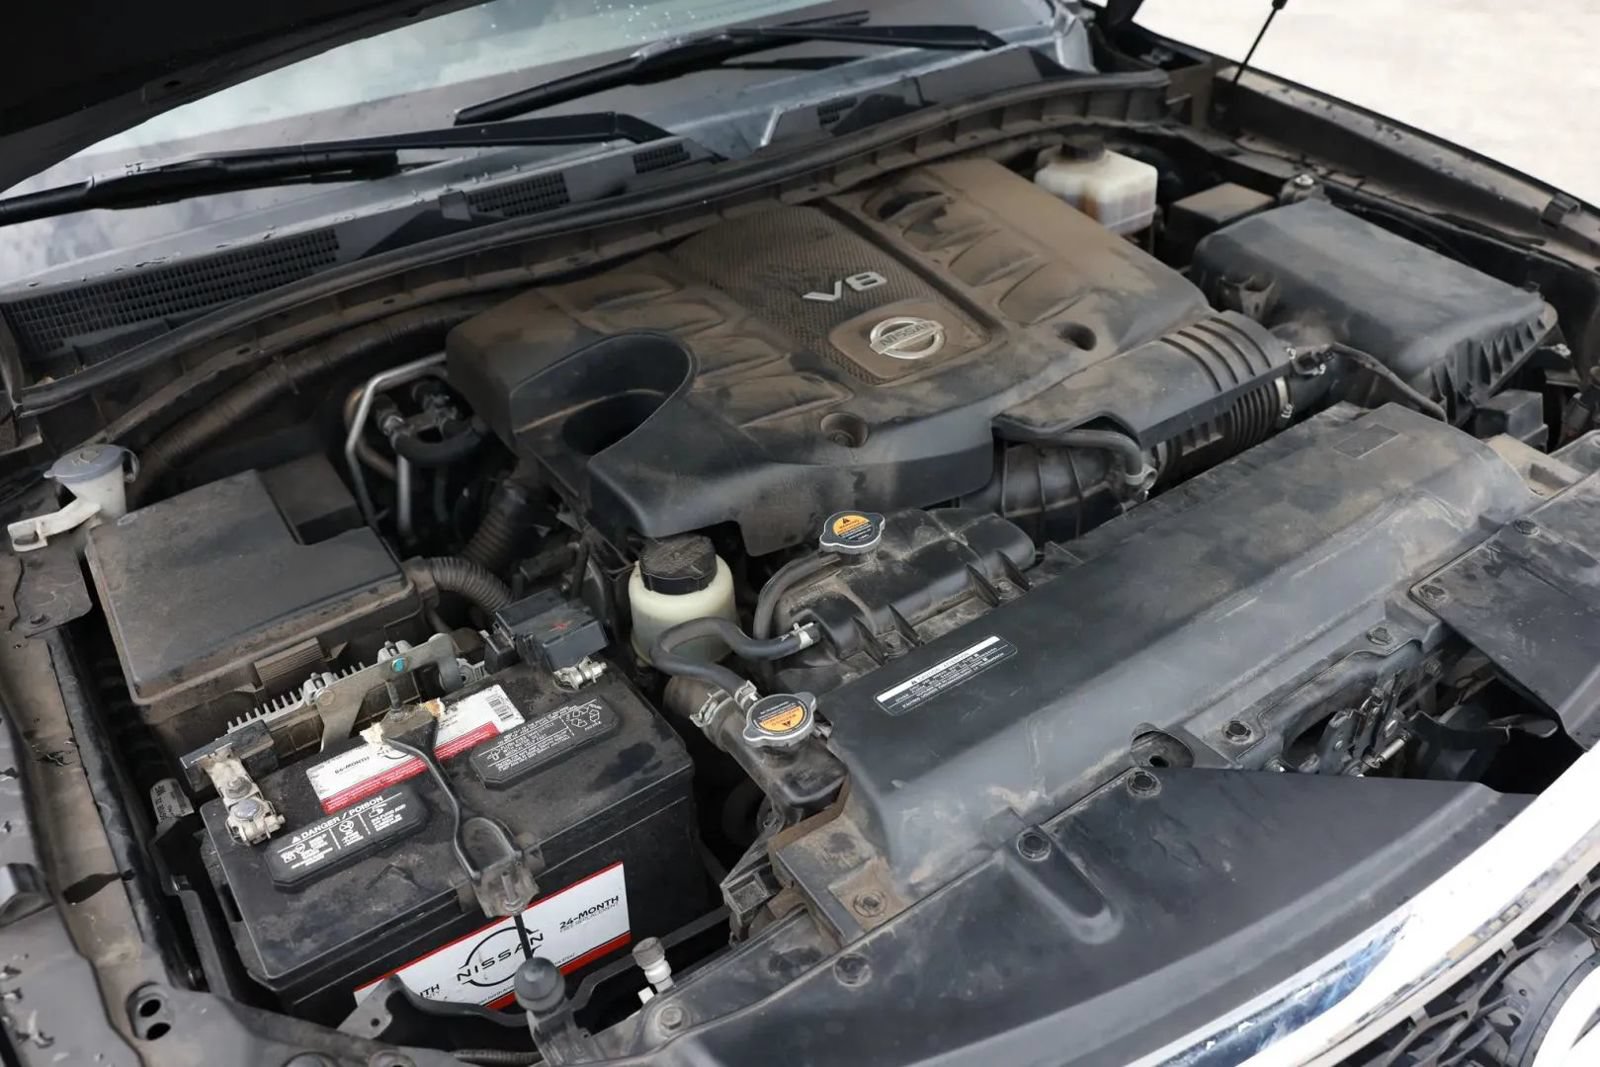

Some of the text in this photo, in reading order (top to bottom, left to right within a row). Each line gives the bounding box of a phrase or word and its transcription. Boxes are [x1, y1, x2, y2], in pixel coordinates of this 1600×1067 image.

[802, 271, 888, 302] V8
[879, 321, 937, 347] NISSAN
[301, 817, 340, 839] DANGER
[349, 795, 384, 816] POISON
[559, 895, 619, 930] 24-MONTH
